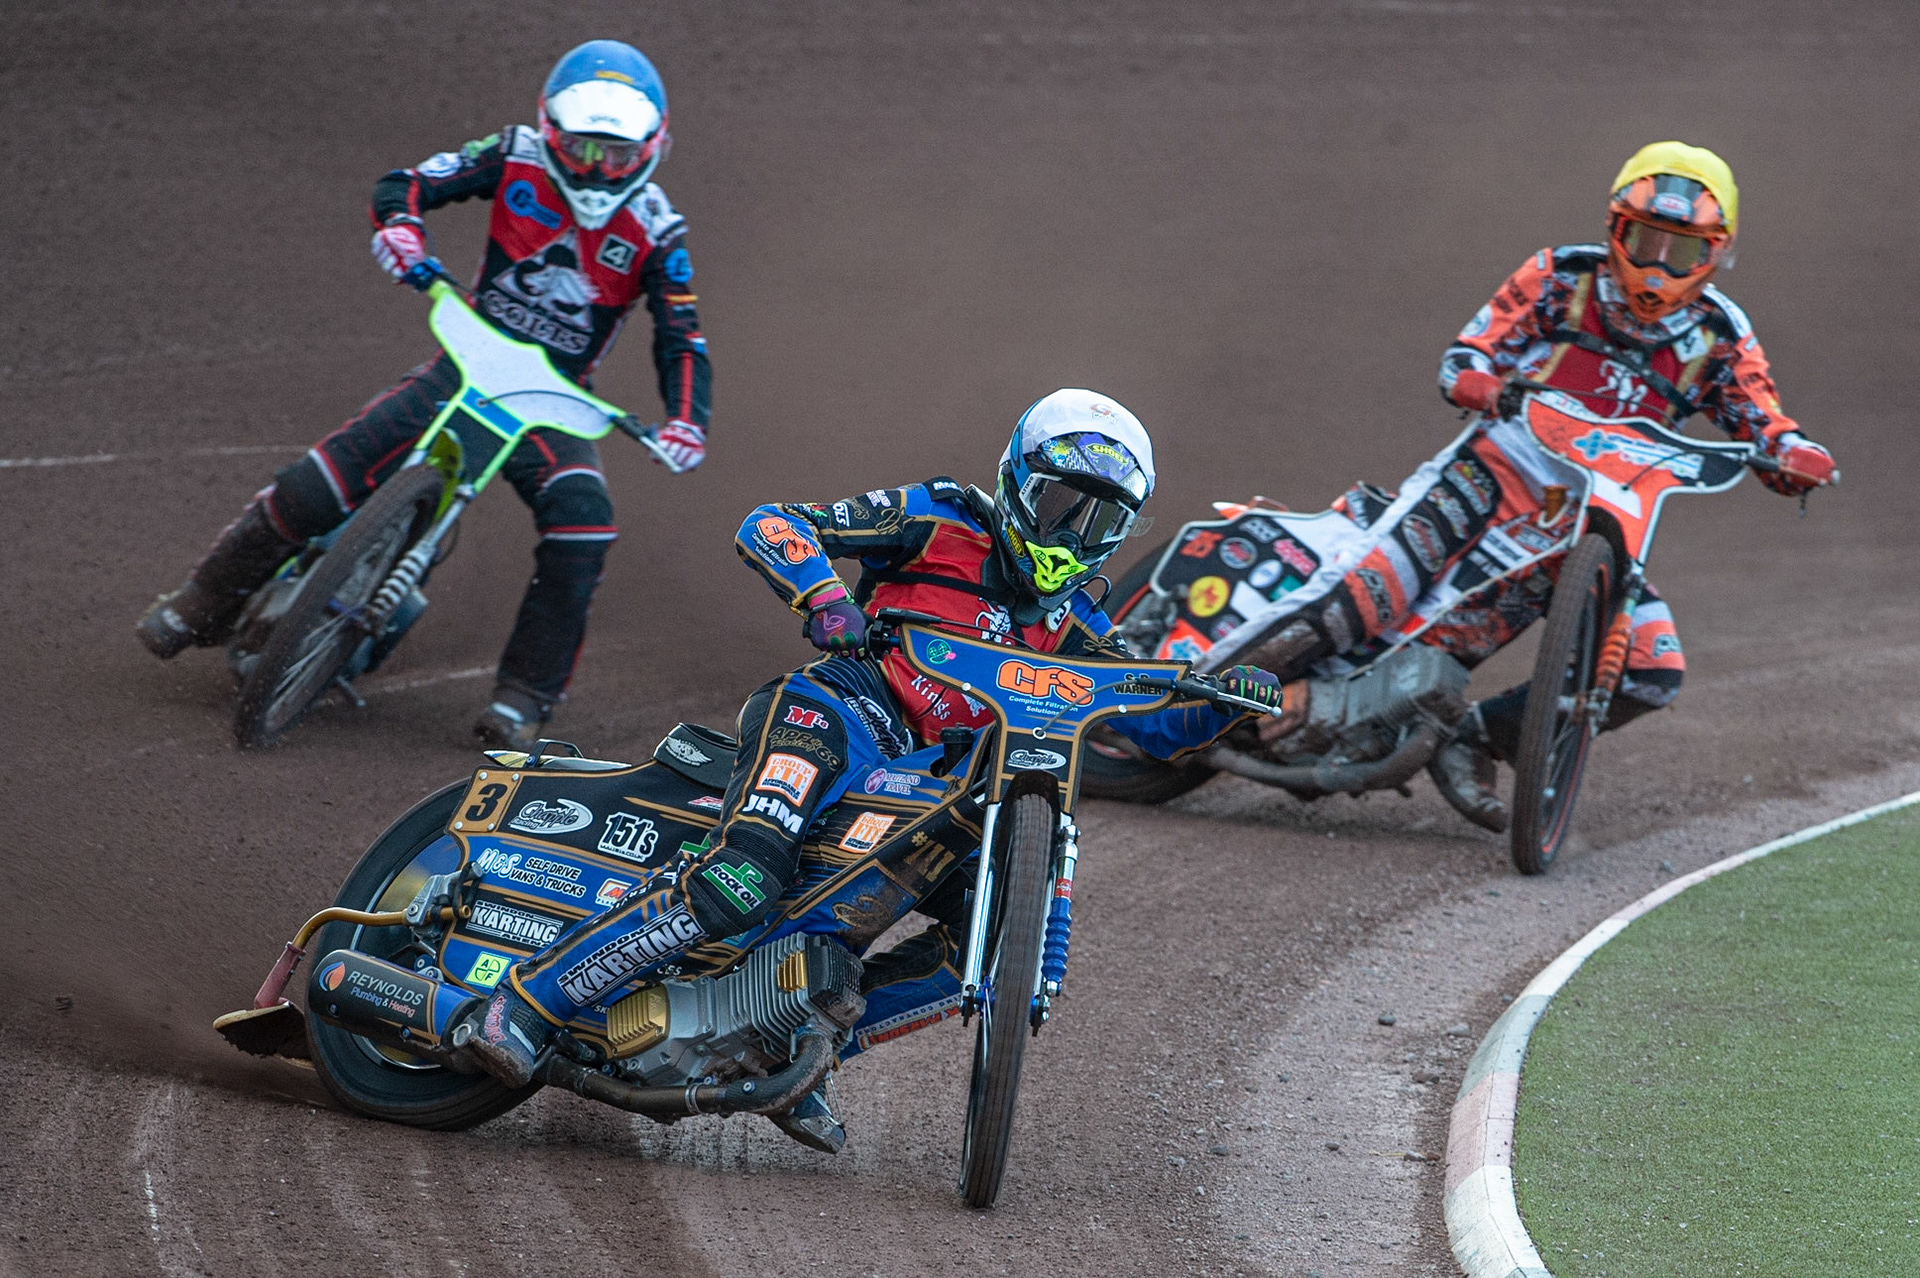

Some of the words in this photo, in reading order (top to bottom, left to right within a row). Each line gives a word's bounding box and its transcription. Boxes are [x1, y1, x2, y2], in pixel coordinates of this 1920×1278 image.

[604, 245, 629, 266] 4
[1092, 443, 1126, 464] SHOEI
[751, 531, 769, 552] Complete
[768, 549, 789, 566] Filtration
[755, 516, 821, 565] CFS
[1007, 524, 1024, 555] SHOEI
[910, 674, 951, 721] Kings
[998, 660, 1094, 706] CFS
[1112, 683, 1164, 696] WARNER
[1229, 678, 1280, 700] FIST
[1008, 695, 1044, 707] Complete
[1045, 701, 1079, 712] Filtraton
[1025, 705, 1060, 716] Solutions
[771, 758, 812, 776] GROUP
[465, 783, 508, 822] 3
[884, 784, 911, 795] TRAVEL
[510, 817, 540, 829] Racing
[520, 801, 580, 829] Chapple
[742, 794, 804, 834] JHM
[602, 813, 657, 856] 151's
[510, 869, 536, 884] VANS
[535, 876, 543, 886] &
[545, 878, 587, 897] TRUCKS
[526, 858, 550, 871] SELF
[549, 863, 581, 880] DRIVE
[710, 865, 744, 894] ROCK
[740, 891, 758, 908] OIL
[476, 900, 535, 919] SWINDON
[470, 907, 558, 943] KARTING
[481, 959, 489, 968] A
[558, 927, 646, 984] SWINDON
[563, 911, 701, 1005] KARTING
[347, 970, 425, 1006] REYNOLDS
[484, 972, 493, 981] F
[350, 986, 383, 1008] Plumbing
[382, 998, 389, 1008] &
[388, 999, 416, 1018] Heating
[857, 1005, 934, 1036] CONTRACTORS
